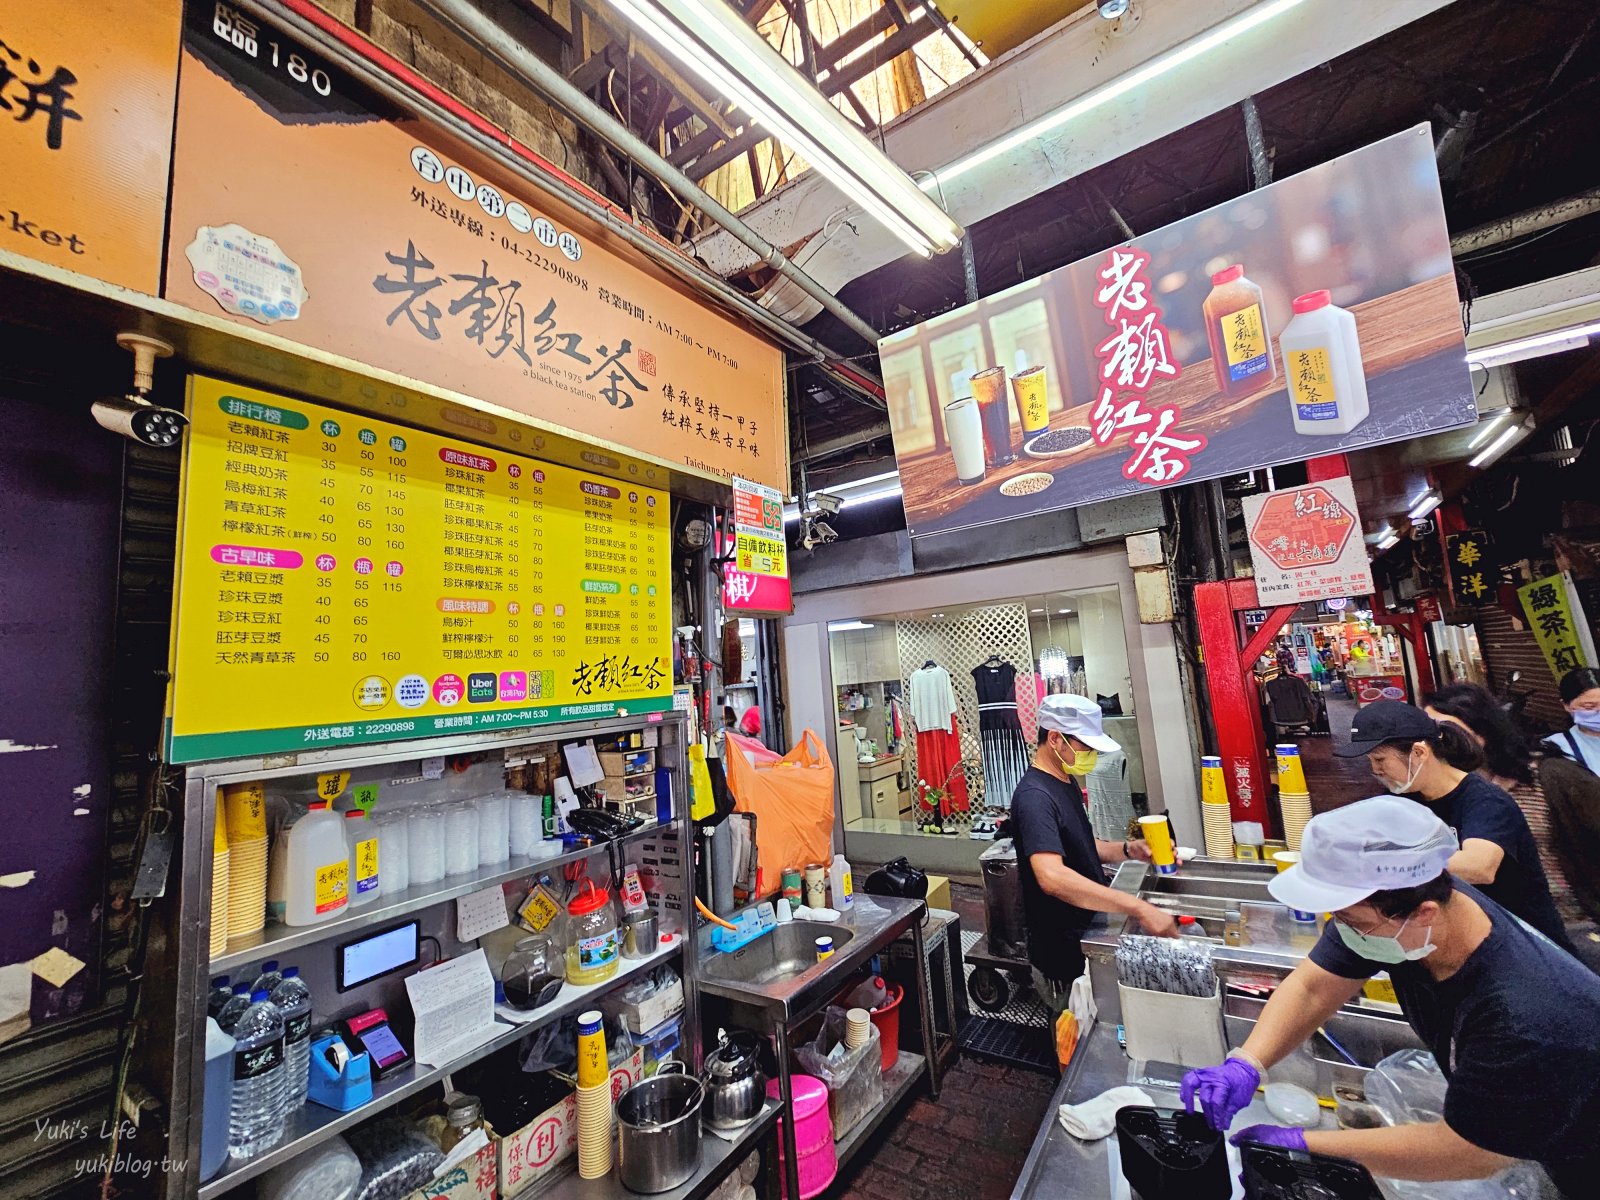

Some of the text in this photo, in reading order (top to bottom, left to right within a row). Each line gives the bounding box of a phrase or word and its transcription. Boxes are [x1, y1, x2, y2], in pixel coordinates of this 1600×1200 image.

[269, 41, 331, 96] 180
[412, 148, 581, 261] 台中第二市場
[0, 210, 85, 254] ket
[372, 239, 649, 410] 老賴紅茶
[1234, 314, 1255, 358] 老賴紅茶
[675, 328, 693, 347] 7:00
[707, 346, 721, 361] PM
[722, 352, 737, 370] 7:00
[539, 362, 582, 384] since 1975
[1095, 251, 1200, 481] 老賴紅茶
[1298, 352, 1322, 402] 老賴紅茶
[530, 371, 553, 387] black
[555, 379, 568, 391] tea
[570, 383, 597, 402] station
[662, 383, 758, 435] 傳承堅持一甲子
[228, 400, 282, 423] 排行榜
[323, 422, 338, 436] 杯
[361, 431, 374, 444] 瓶
[227, 421, 406, 467] 老賴紅茶 30 50 100
[662, 409, 760, 458] 純粹天然古早味
[226, 440, 406, 484] 招牌豆紅 35 55 115
[444, 452, 544, 483] 原味紅茶 杯 瓶
[684, 455, 720, 477] Taichung
[225, 460, 406, 500] 經典奶茶 45 70 145
[445, 467, 542, 495] 珍珠紅茶 35 55
[224, 480, 404, 516] 烏梅紅茶 40 65 130
[444, 483, 485, 499] 椰果紅茶
[533, 501, 542, 509] 65
[584, 497, 613, 510] 珍珠奶茶
[224, 500, 405, 533] 青草紅茶 40 65 130
[444, 499, 542, 523] 胚芽紅茶 40 65
[444, 514, 542, 537] 珍珠椰果紅茶 45 70
[584, 523, 613, 535] 胚芽奶茶
[322, 533, 336, 542] 50
[358, 537, 371, 546] 80
[387, 540, 404, 550] 160
[444, 530, 542, 551] 珍珠胚芽紅茶 45 70
[738, 537, 784, 557] 自備飲料杯
[221, 548, 275, 565] 古早味
[318, 556, 333, 570] 杯
[356, 560, 370, 573] 瓶
[443, 546, 542, 565] 椰果胚芽紅茶 50 80
[533, 571, 542, 579] 70
[1457, 541, 1488, 599] 華洋
[220, 571, 402, 592] 老賴豆漿 35 55 115
[443, 578, 503, 592] 珍珠檸檬紅茶
[219, 591, 368, 607] 珍珠豆漿 40 65
[442, 601, 489, 612] 風味特調
[508, 603, 519, 614] 杯
[585, 596, 607, 605] 鮮奶茶
[218, 611, 367, 625] 珍珠豆紅 40 65
[443, 617, 473, 628] 烏梅汁
[508, 620, 518, 628] 50
[533, 621, 542, 629] 80
[217, 631, 367, 644] 胚芽豆漿 45 70
[443, 634, 494, 643] 鮮榨檸檬汁
[508, 635, 518, 643] 60
[215, 651, 400, 665] 天然青草茶 50 80 160
[443, 650, 503, 659] 可爾必思冰飲
[472, 679, 492, 688] Uber
[572, 654, 665, 696] 老賴紅茶
[472, 688, 493, 697] Eats
[533, 710, 548, 718] 5:30
[561, 703, 614, 716] 所有飲品甜度固定
[323, 776, 340, 796] 罐
[360, 790, 375, 803] 瓶
